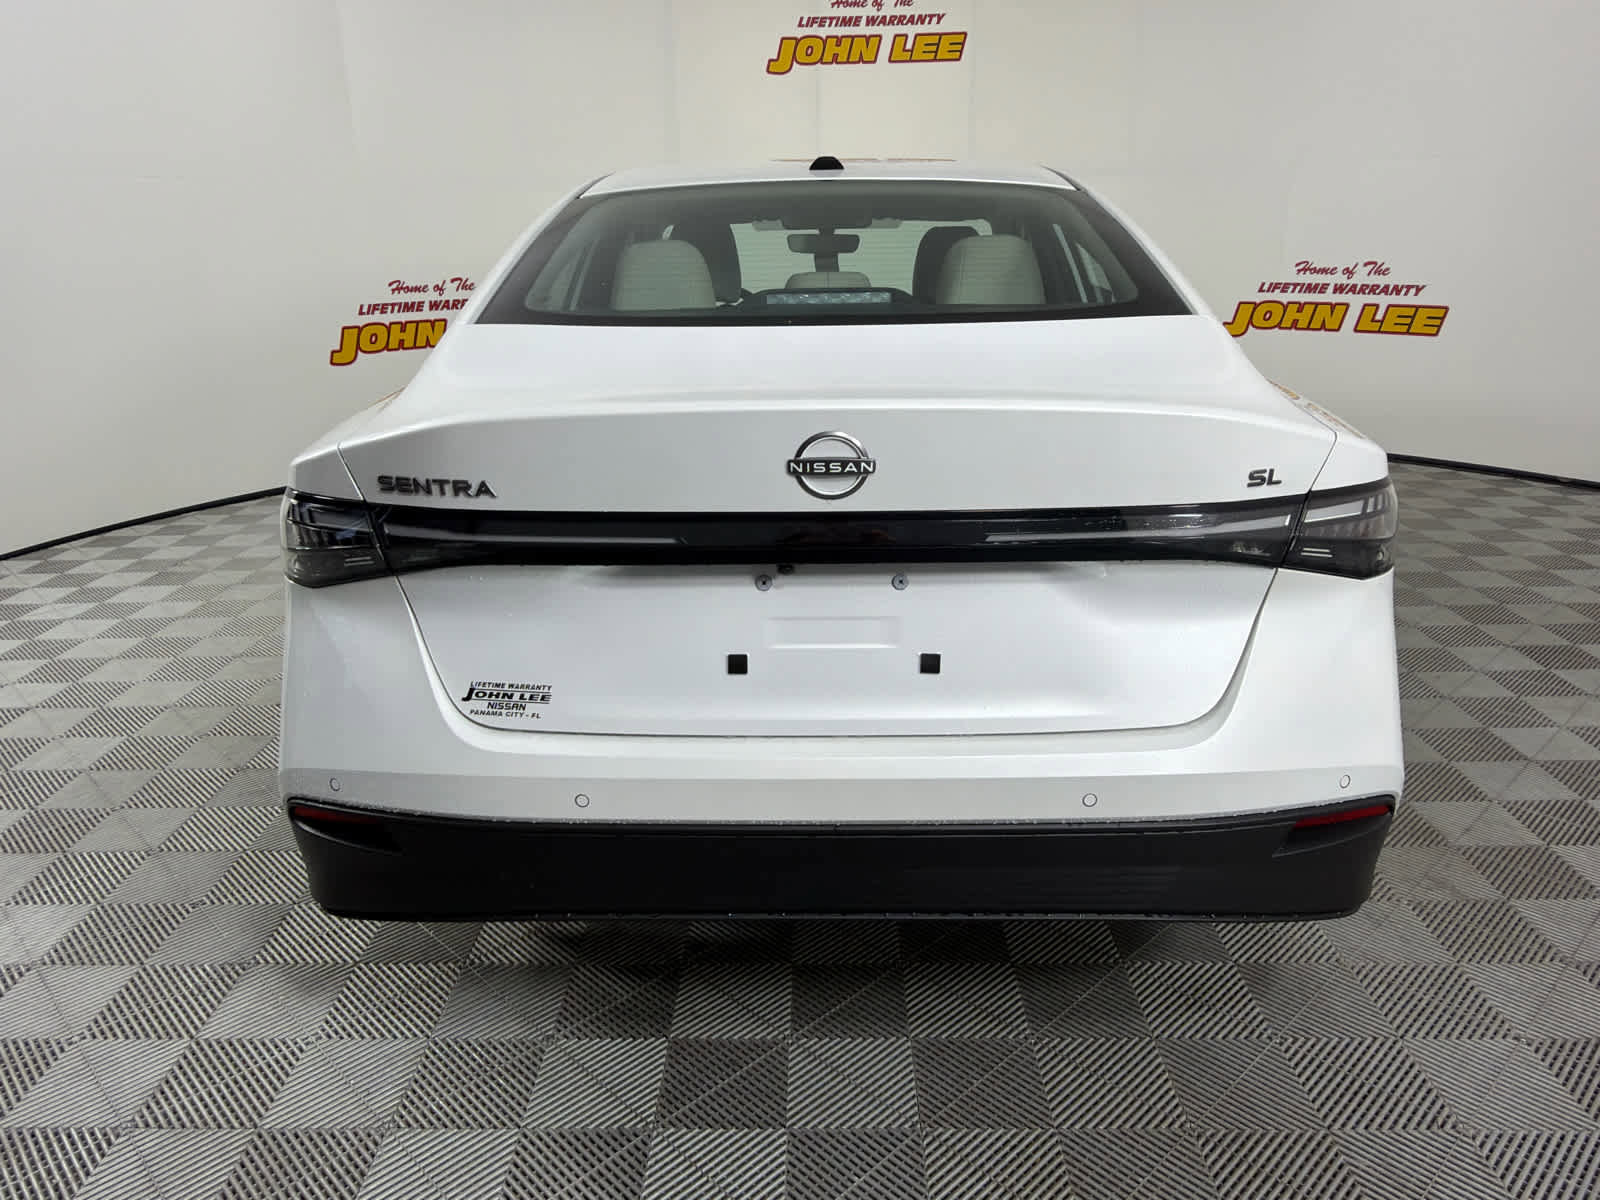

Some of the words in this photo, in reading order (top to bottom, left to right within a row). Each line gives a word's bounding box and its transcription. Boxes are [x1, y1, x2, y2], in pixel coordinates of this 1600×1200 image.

[797, 15, 862, 28] LIFETIME
[865, 13, 946, 27] WARRANTY
[766, 34, 882, 75] JOHN
[888, 32, 967, 63] LEE
[1294, 260, 1338, 276] Home
[1342, 263, 1359, 280] of
[1362, 261, 1391, 277] The
[388, 280, 429, 295] Home
[433, 280, 446, 296] of
[450, 277, 475, 293] The
[1257, 282, 1330, 294] LIFETIME
[1332, 284, 1426, 297] WARRANTY
[358, 301, 424, 316] LIFETIME
[1222, 300, 1350, 338] JOHN
[1353, 303, 1450, 337] LEE
[330, 318, 448, 366] JOHN
[789, 461, 874, 473] NISSAN
[1246, 468, 1282, 488] SL
[377, 475, 497, 498] SENTRA
[470, 681, 506, 689] LIFETIME
[508, 682, 552, 691] WARRANTY
[461, 687, 514, 702] JOHN
[518, 693, 552, 702] LEE
[470, 709, 503, 717] PANAMA
[487, 702, 527, 711] NISSAN
